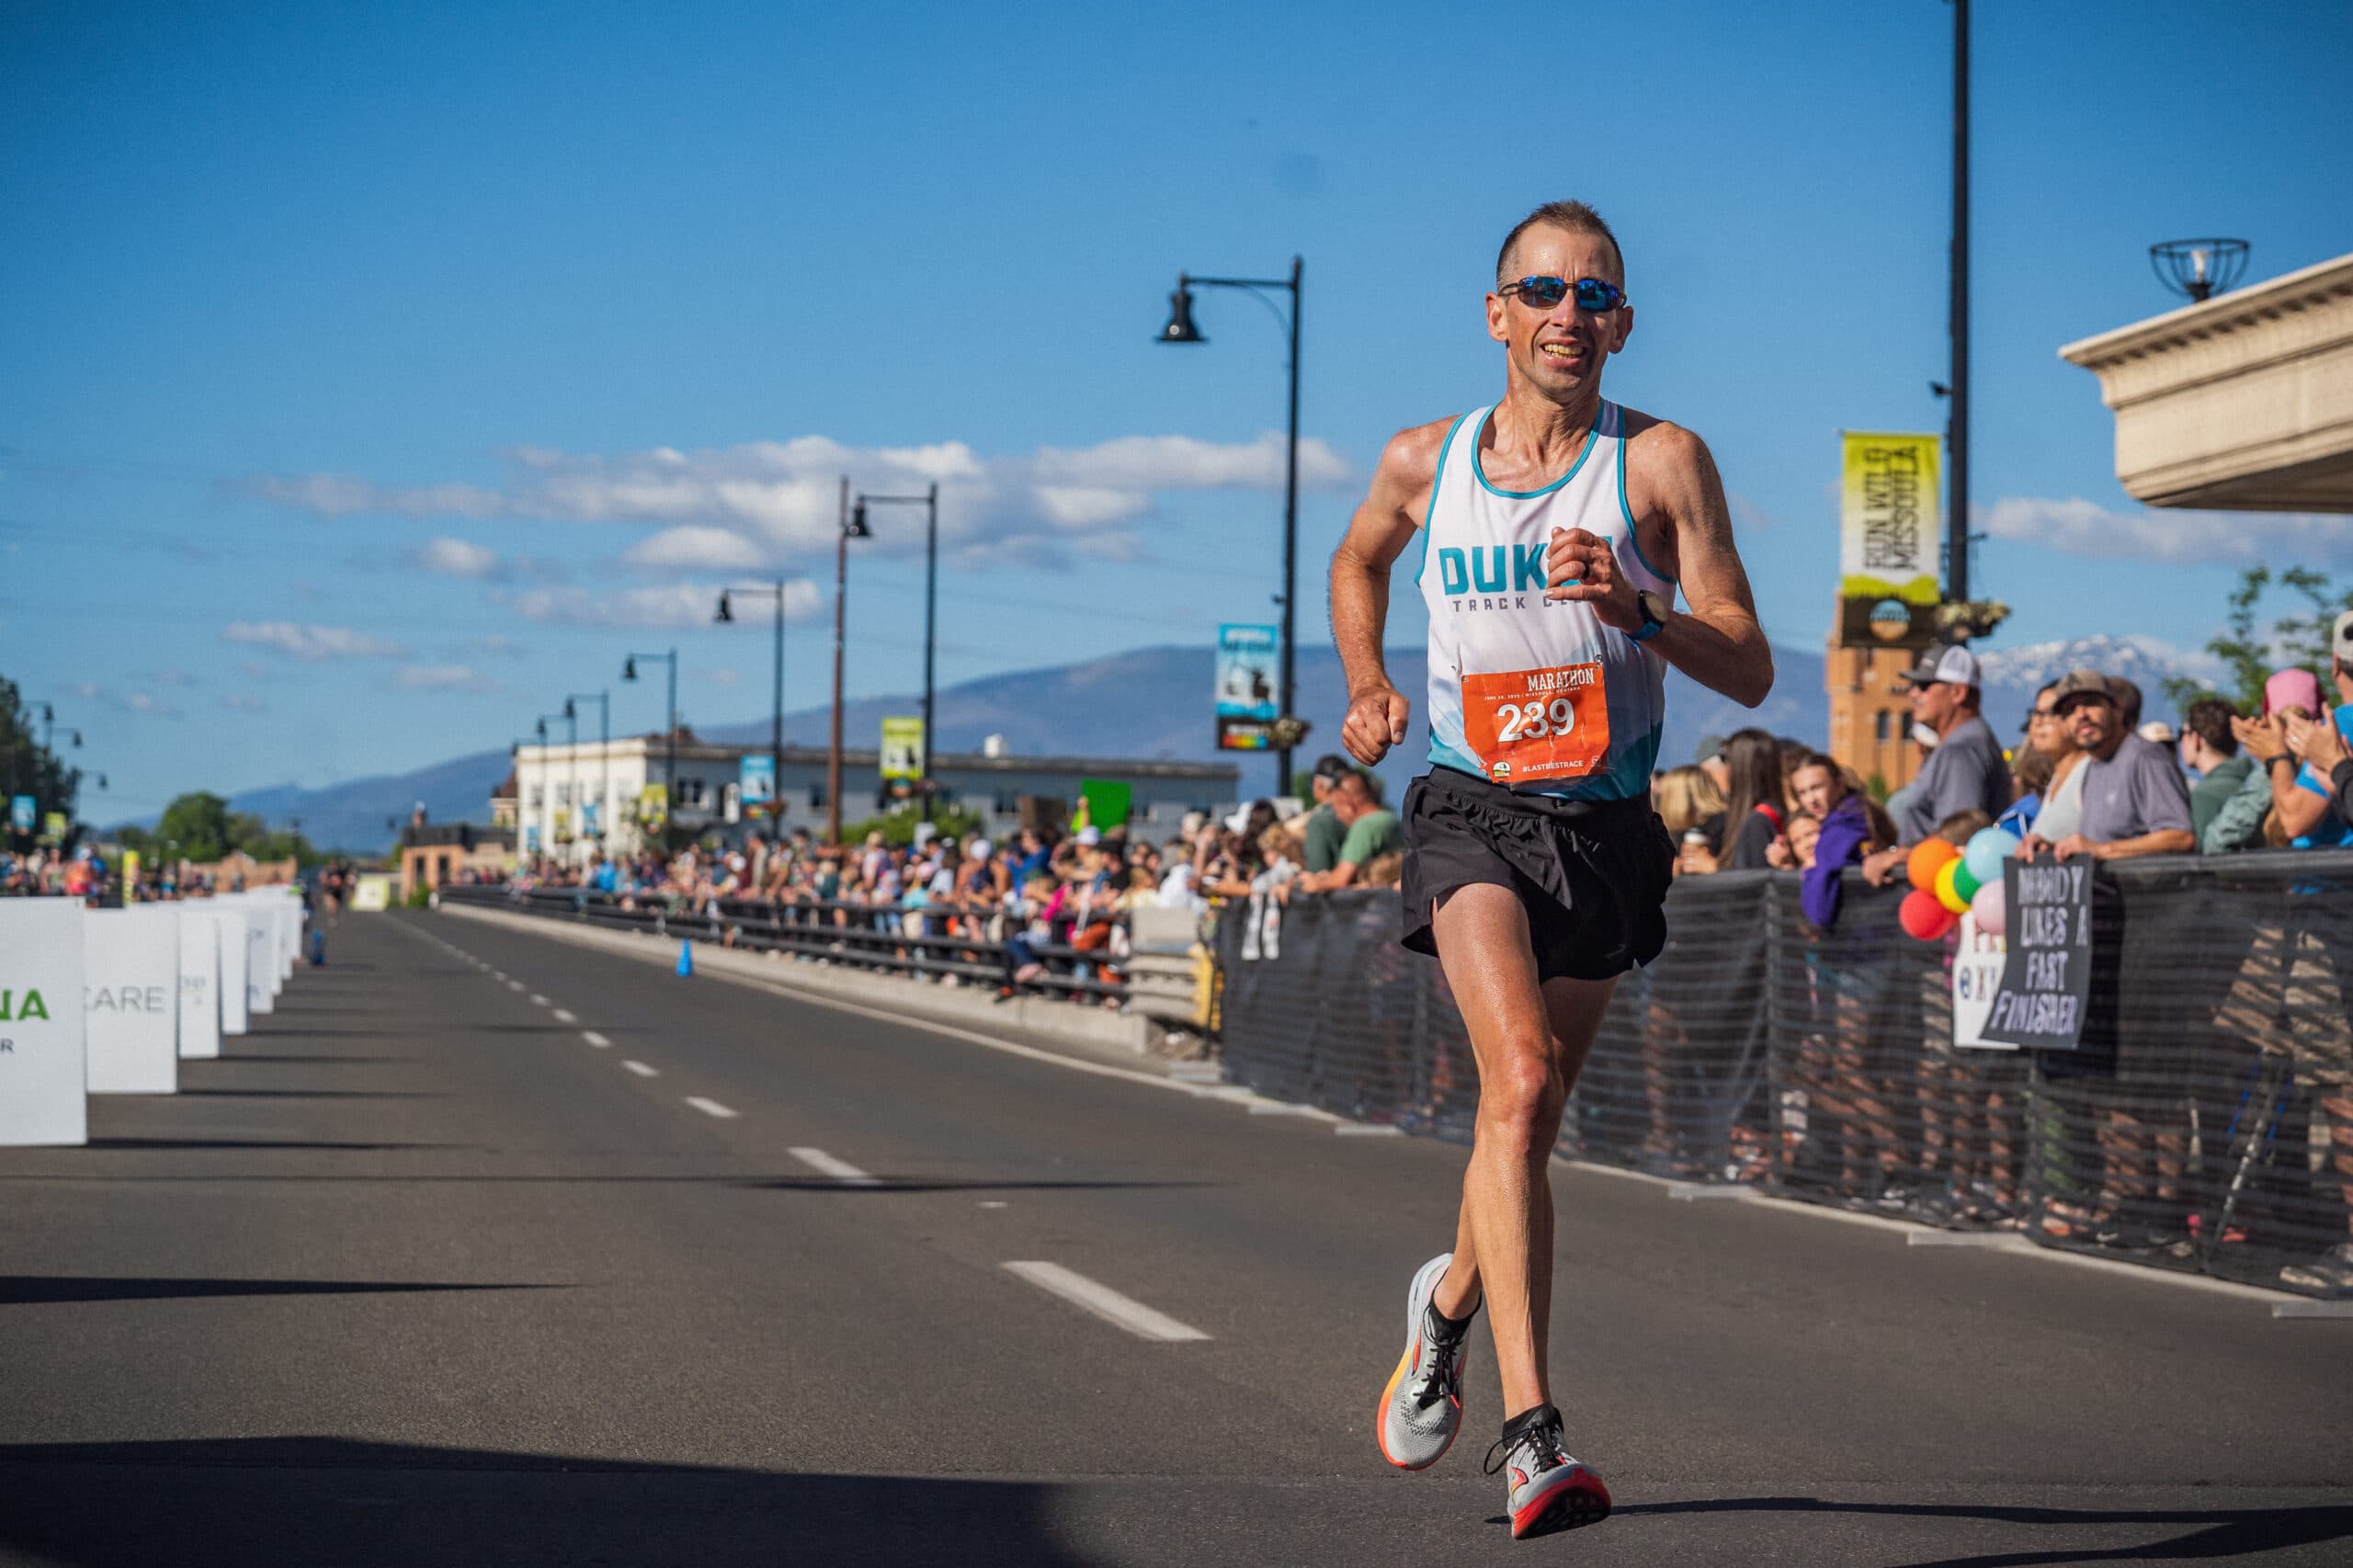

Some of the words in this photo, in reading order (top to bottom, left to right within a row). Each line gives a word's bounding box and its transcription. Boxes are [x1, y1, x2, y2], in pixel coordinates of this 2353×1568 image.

[1891, 446, 1919, 571] MISSOULA
[1863, 520, 1888, 569] RUN
[1453, 597, 1526, 612] TRACK
[1528, 668, 1595, 691] MARATHON
[1497, 699, 1574, 742] 239
[1522, 760, 1584, 772] #LASTBESTRACE
[2075, 904, 2087, 947] A
[2026, 951, 2068, 991] FAST
[84, 985, 165, 1013] ARE
[1990, 991, 2077, 1035] FINISHER
